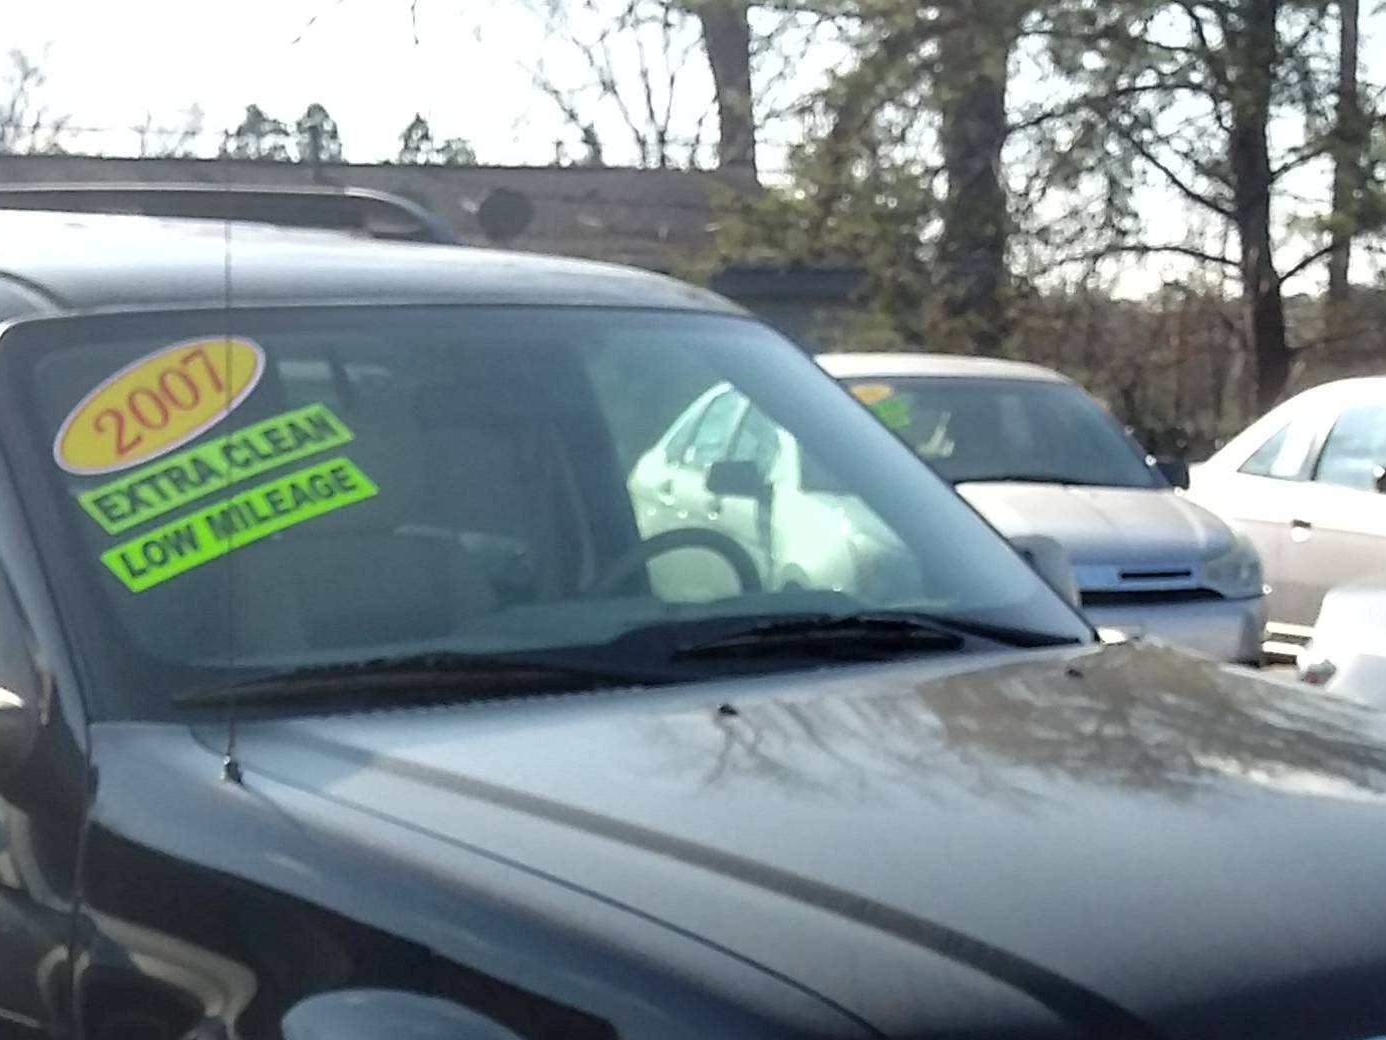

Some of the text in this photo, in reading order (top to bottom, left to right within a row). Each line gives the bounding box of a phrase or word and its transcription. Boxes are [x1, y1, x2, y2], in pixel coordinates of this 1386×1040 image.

[94, 350, 226, 456] 2007
[95, 410, 339, 524] EXTRA CLEAN
[120, 464, 359, 579] LOW MILEAGE
